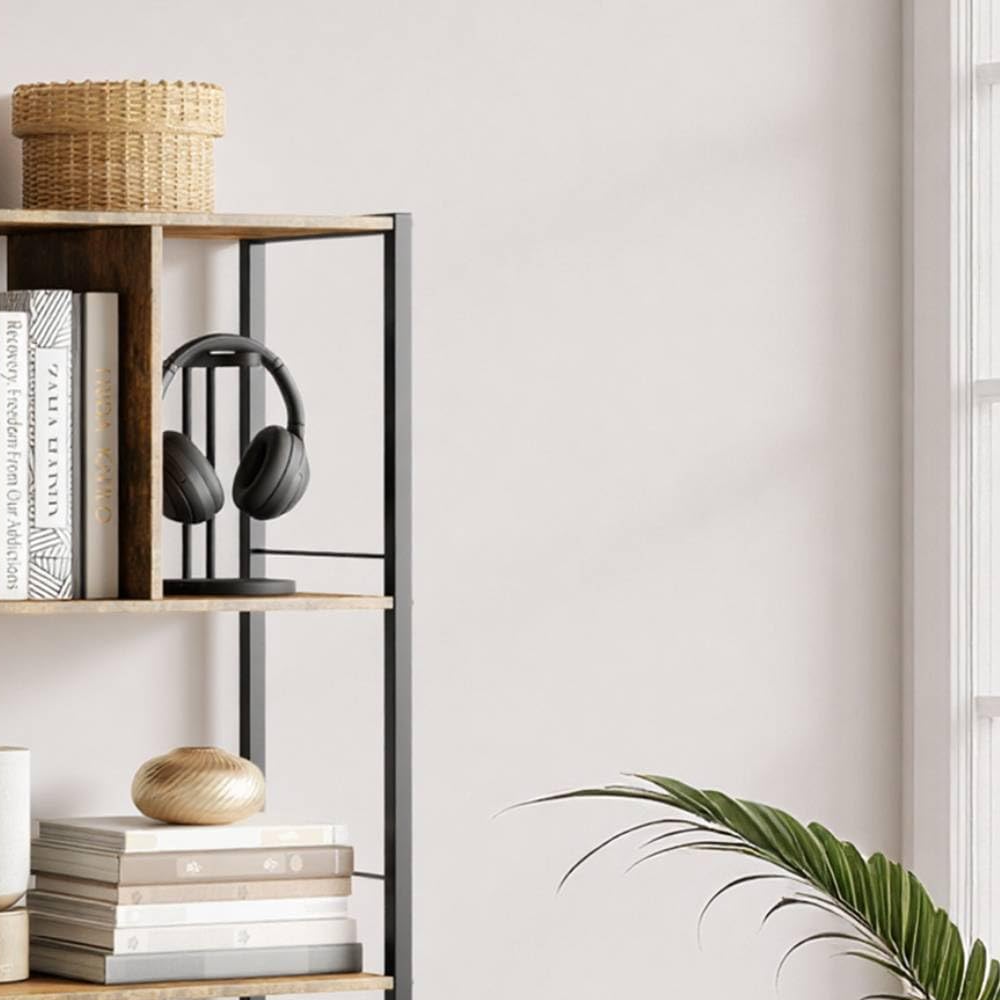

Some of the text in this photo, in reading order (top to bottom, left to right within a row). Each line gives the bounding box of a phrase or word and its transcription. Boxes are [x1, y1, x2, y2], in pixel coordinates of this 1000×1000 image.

[7, 389, 22, 449] Freedom
[7, 451, 22, 486] From
[7, 490, 22, 516] Our
[6, 519, 21, 590] Addictions
